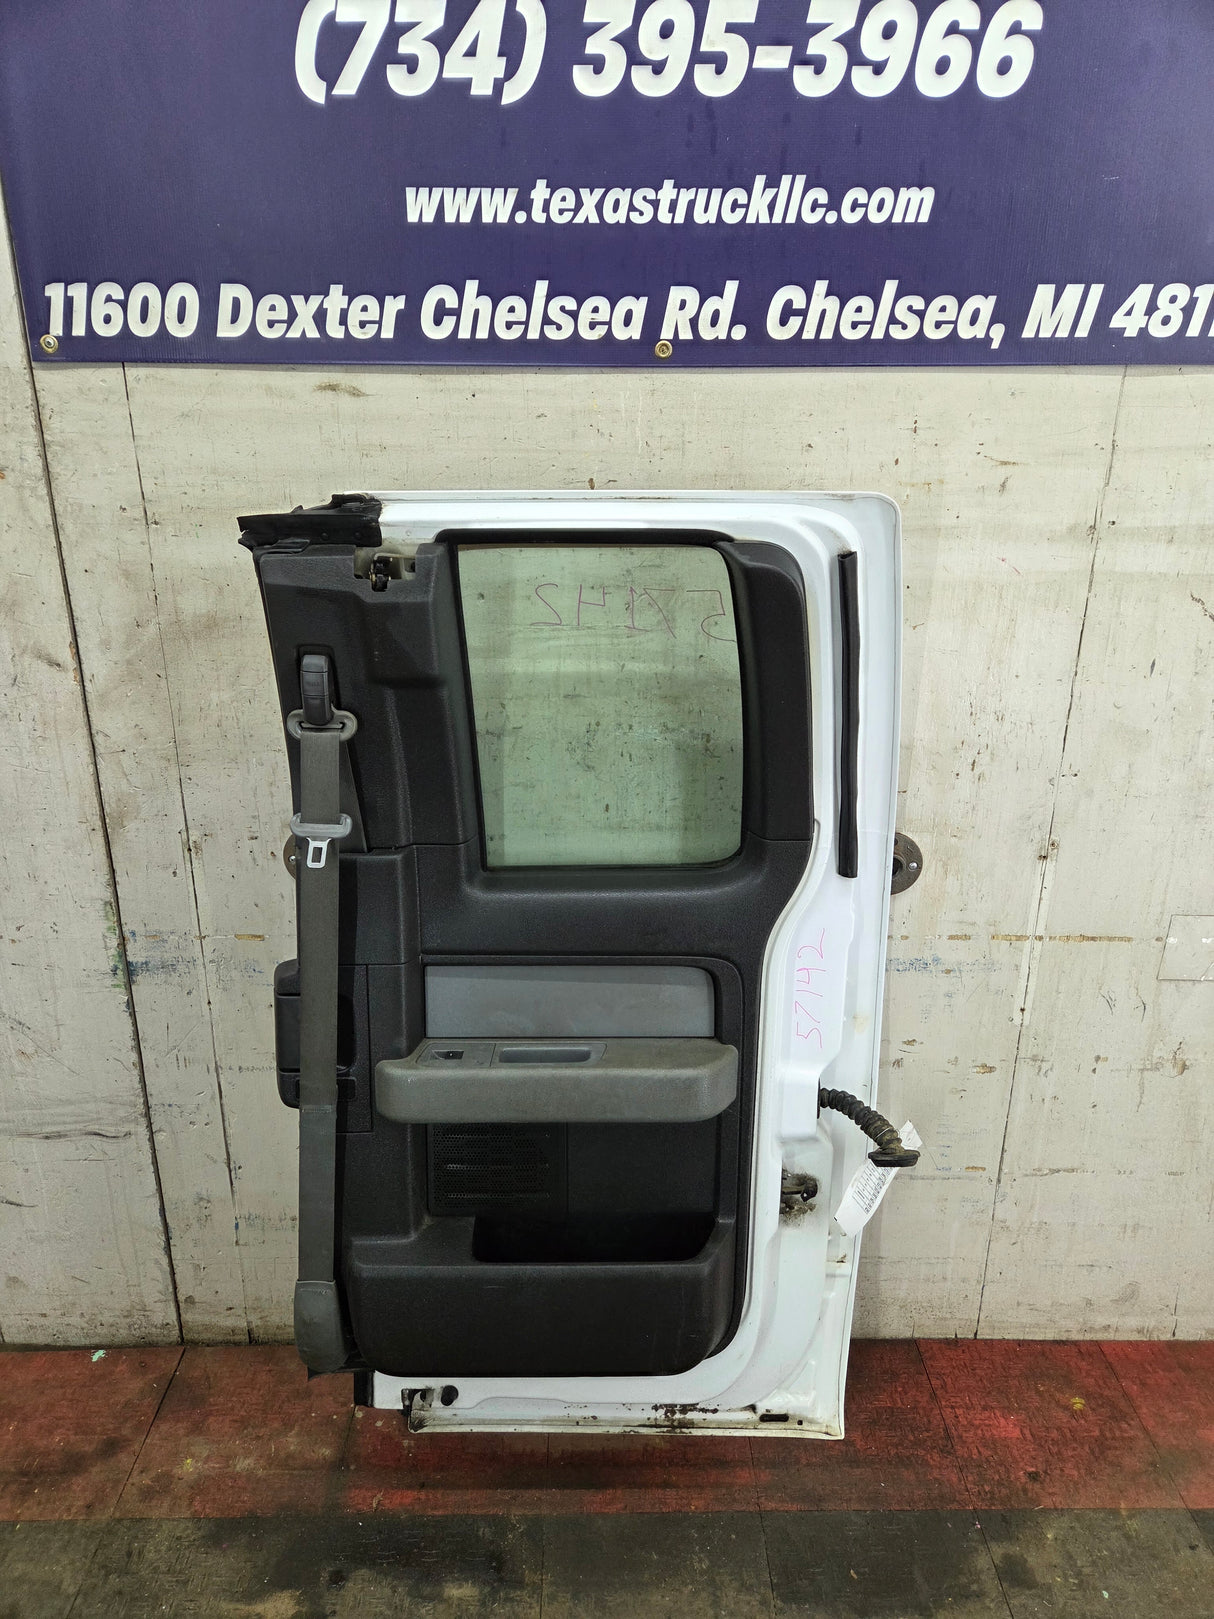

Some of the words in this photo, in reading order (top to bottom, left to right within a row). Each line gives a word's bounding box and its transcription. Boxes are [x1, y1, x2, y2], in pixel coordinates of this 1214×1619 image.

[294, 0, 548, 105] (734)
[572, 0, 1044, 98] 395-3966
[405, 174, 936, 225] www.texastruckllc.com
[44, 281, 200, 338] 11600
[216, 283, 406, 340] Dexter
[420, 279, 649, 341] Chelsea
[660, 280, 748, 341] Rd.
[765, 279, 1006, 350] Chelsea,
[1021, 283, 1105, 339] MI
[1108, 282, 1214, 338] 481
[794, 927, 827, 1050] 57142
